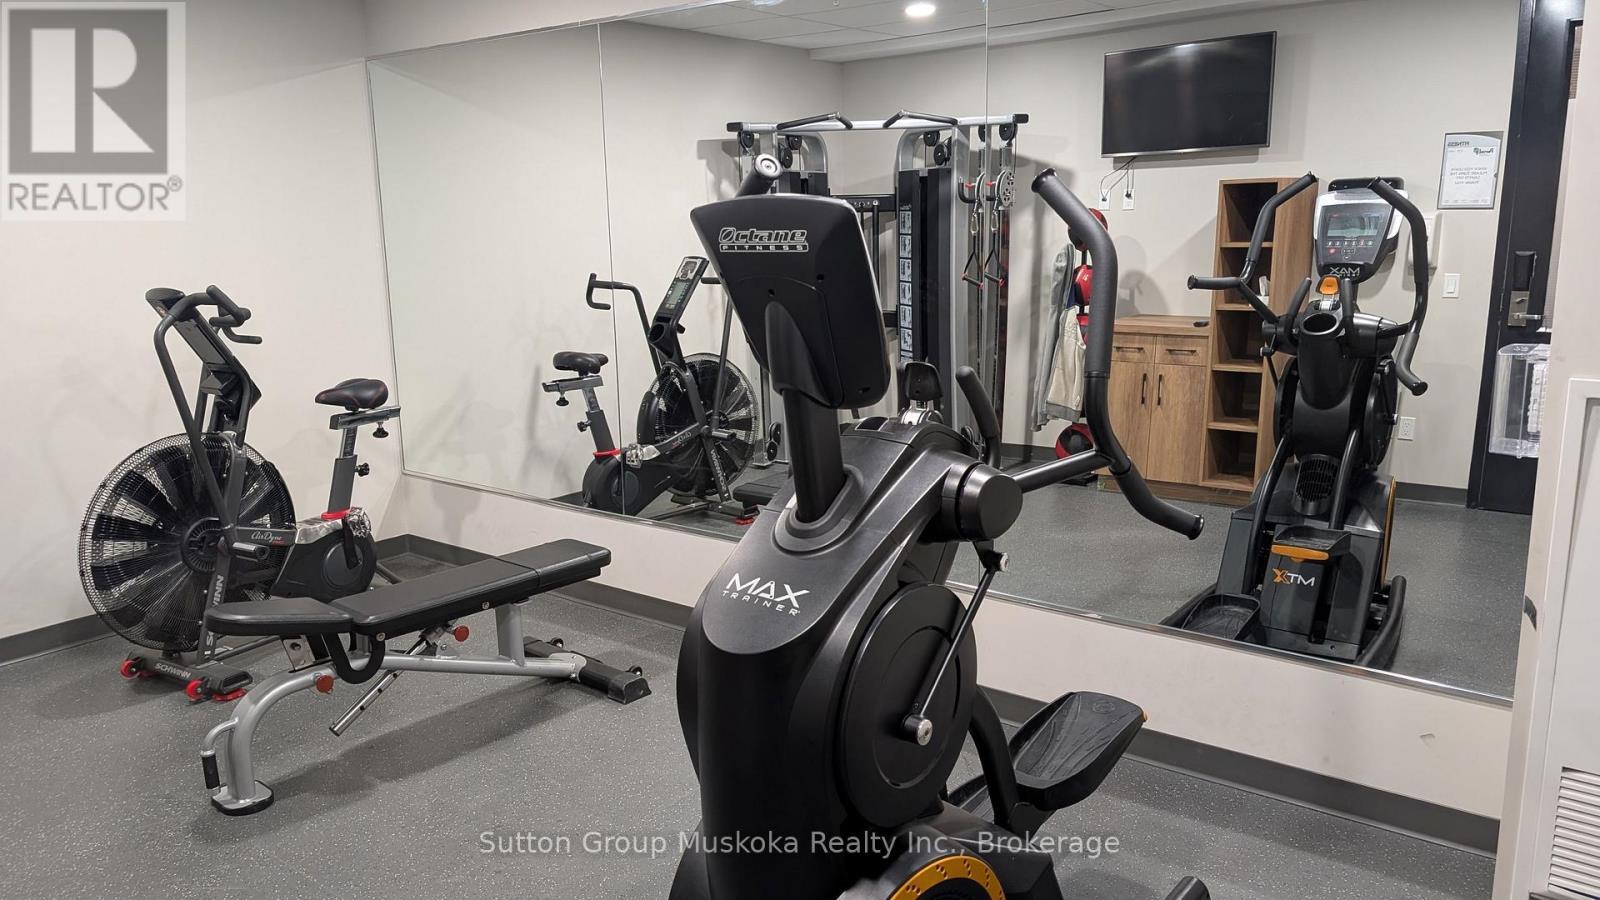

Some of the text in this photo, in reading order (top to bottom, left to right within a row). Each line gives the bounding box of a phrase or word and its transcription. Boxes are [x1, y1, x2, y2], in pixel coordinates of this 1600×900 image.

[719, 227, 808, 243] Octane
[726, 573, 811, 608] MAX
[722, 590, 800, 616] TRAINER
[154, 662, 192, 679] SCHWINN
